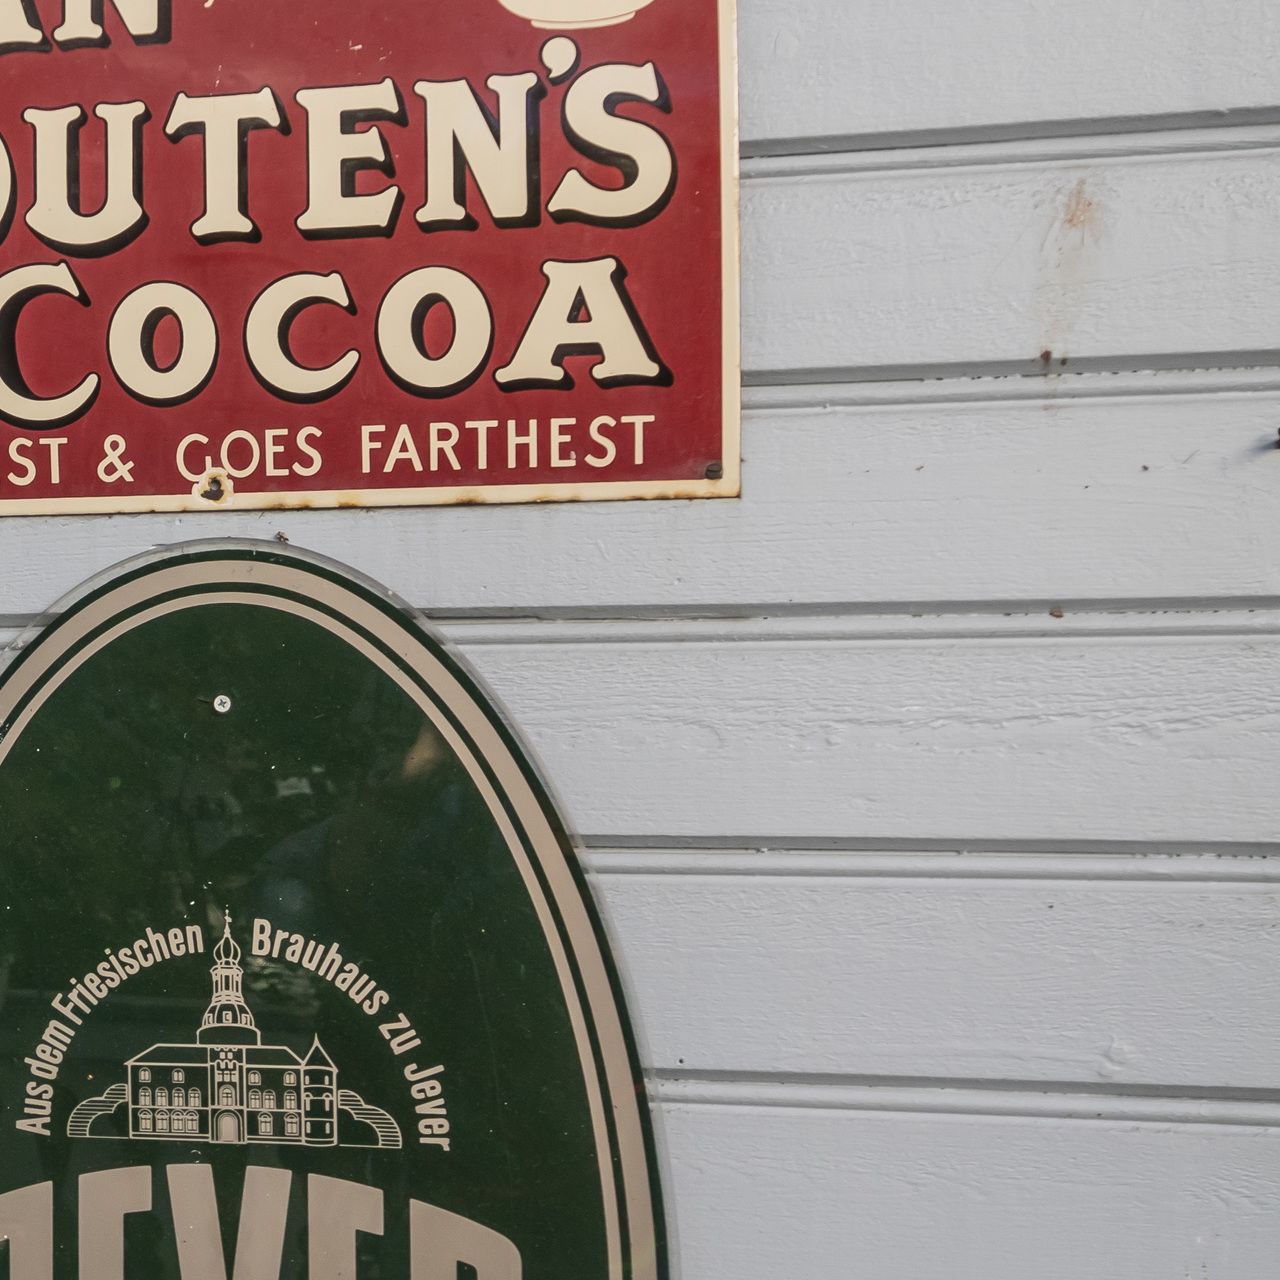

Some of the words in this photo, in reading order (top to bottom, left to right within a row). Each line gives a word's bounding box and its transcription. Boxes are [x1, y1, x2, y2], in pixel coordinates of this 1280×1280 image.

[98, 437, 136, 483] &
[175, 426, 324, 481] GOES
[360, 415, 657, 475] FARTHEST
[52, 923, 204, 1026] Friesischen
[251, 918, 389, 1015] Brauhaus
[28, 1021, 72, 1081] dem
[378, 1012, 423, 1056] zu
[16, 1081, 53, 1136] Aus
[404, 1060, 451, 1152] Jever
